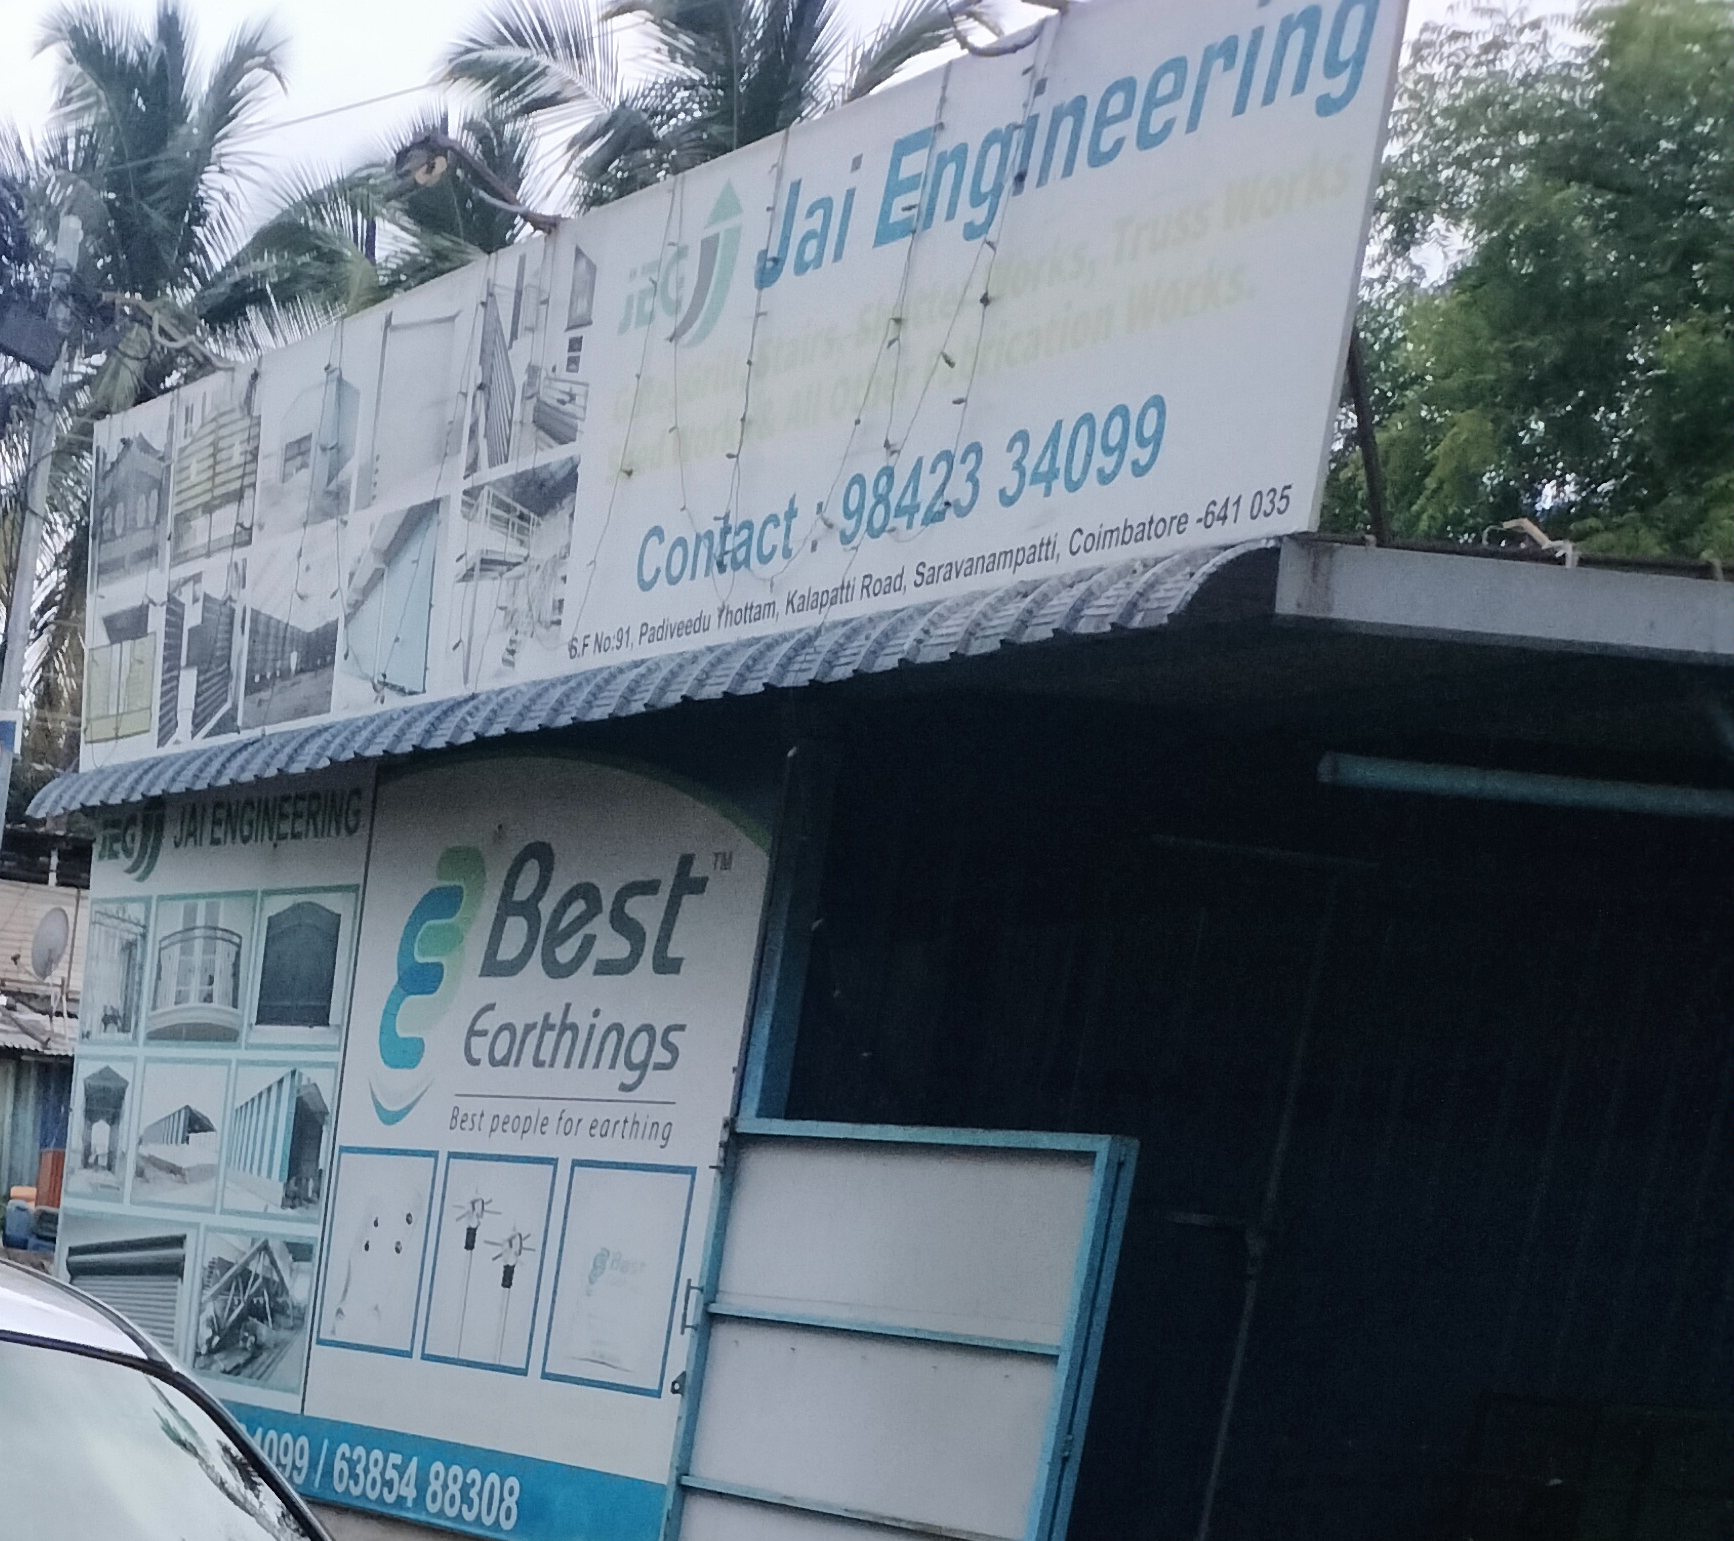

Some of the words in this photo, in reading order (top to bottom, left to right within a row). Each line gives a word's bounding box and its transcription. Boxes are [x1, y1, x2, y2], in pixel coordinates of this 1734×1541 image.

[754, 153, 863, 290] Jai
[872, 0, 1379, 249] Engineering
[636, 493, 799, 593] Contact
[838, 441, 984, 546] 98423
[998, 394, 1167, 508] 34099
[638, 608, 712, 647] Padiveedu
[716, 598, 781, 630] Thottam,
[785, 576, 856, 616] Kalapatti
[860, 564, 908, 601] Road,
[913, 532, 1061, 588] Saravanampatti,
[1068, 510, 1189, 557] Coimbatore
[1195, 494, 1242, 530] -641
[1249, 483, 1294, 522] 035
[173, 799, 204, 849] JAI
[209, 787, 363, 847] ENGINEERING
[478, 840, 710, 980] Best
[463, 1001, 688, 1093] Earthings
[449, 1105, 485, 1133] Best
[488, 1107, 550, 1140] people
[555, 1109, 583, 1137] for
[588, 1111, 674, 1150] earthing
[332, 1442, 419, 1508] 63854
[425, 1460, 521, 1531] 88308
